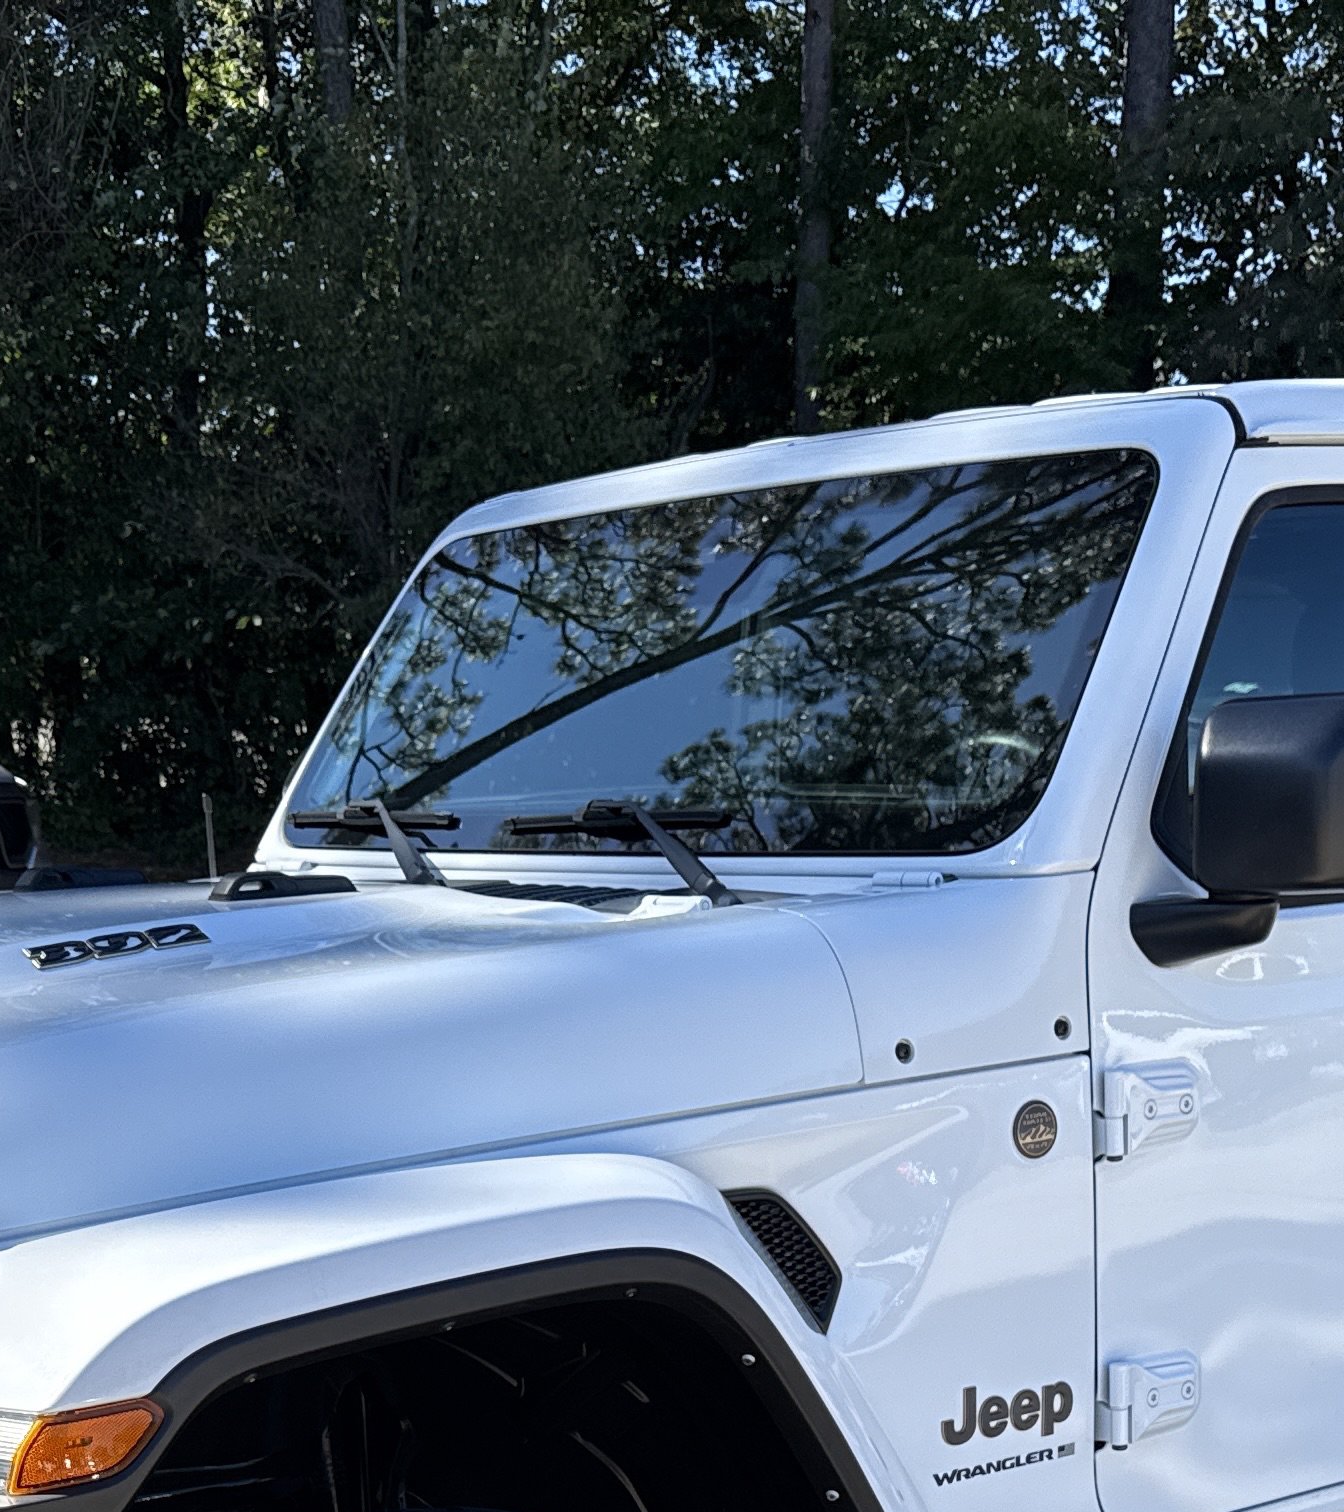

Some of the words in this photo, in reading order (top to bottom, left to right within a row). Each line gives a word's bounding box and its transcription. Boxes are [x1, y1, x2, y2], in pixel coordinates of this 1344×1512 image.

[22, 924, 211, 970] 392
[941, 1381, 1073, 1445] Jeep
[933, 1449, 1053, 1487] WRANGLER
